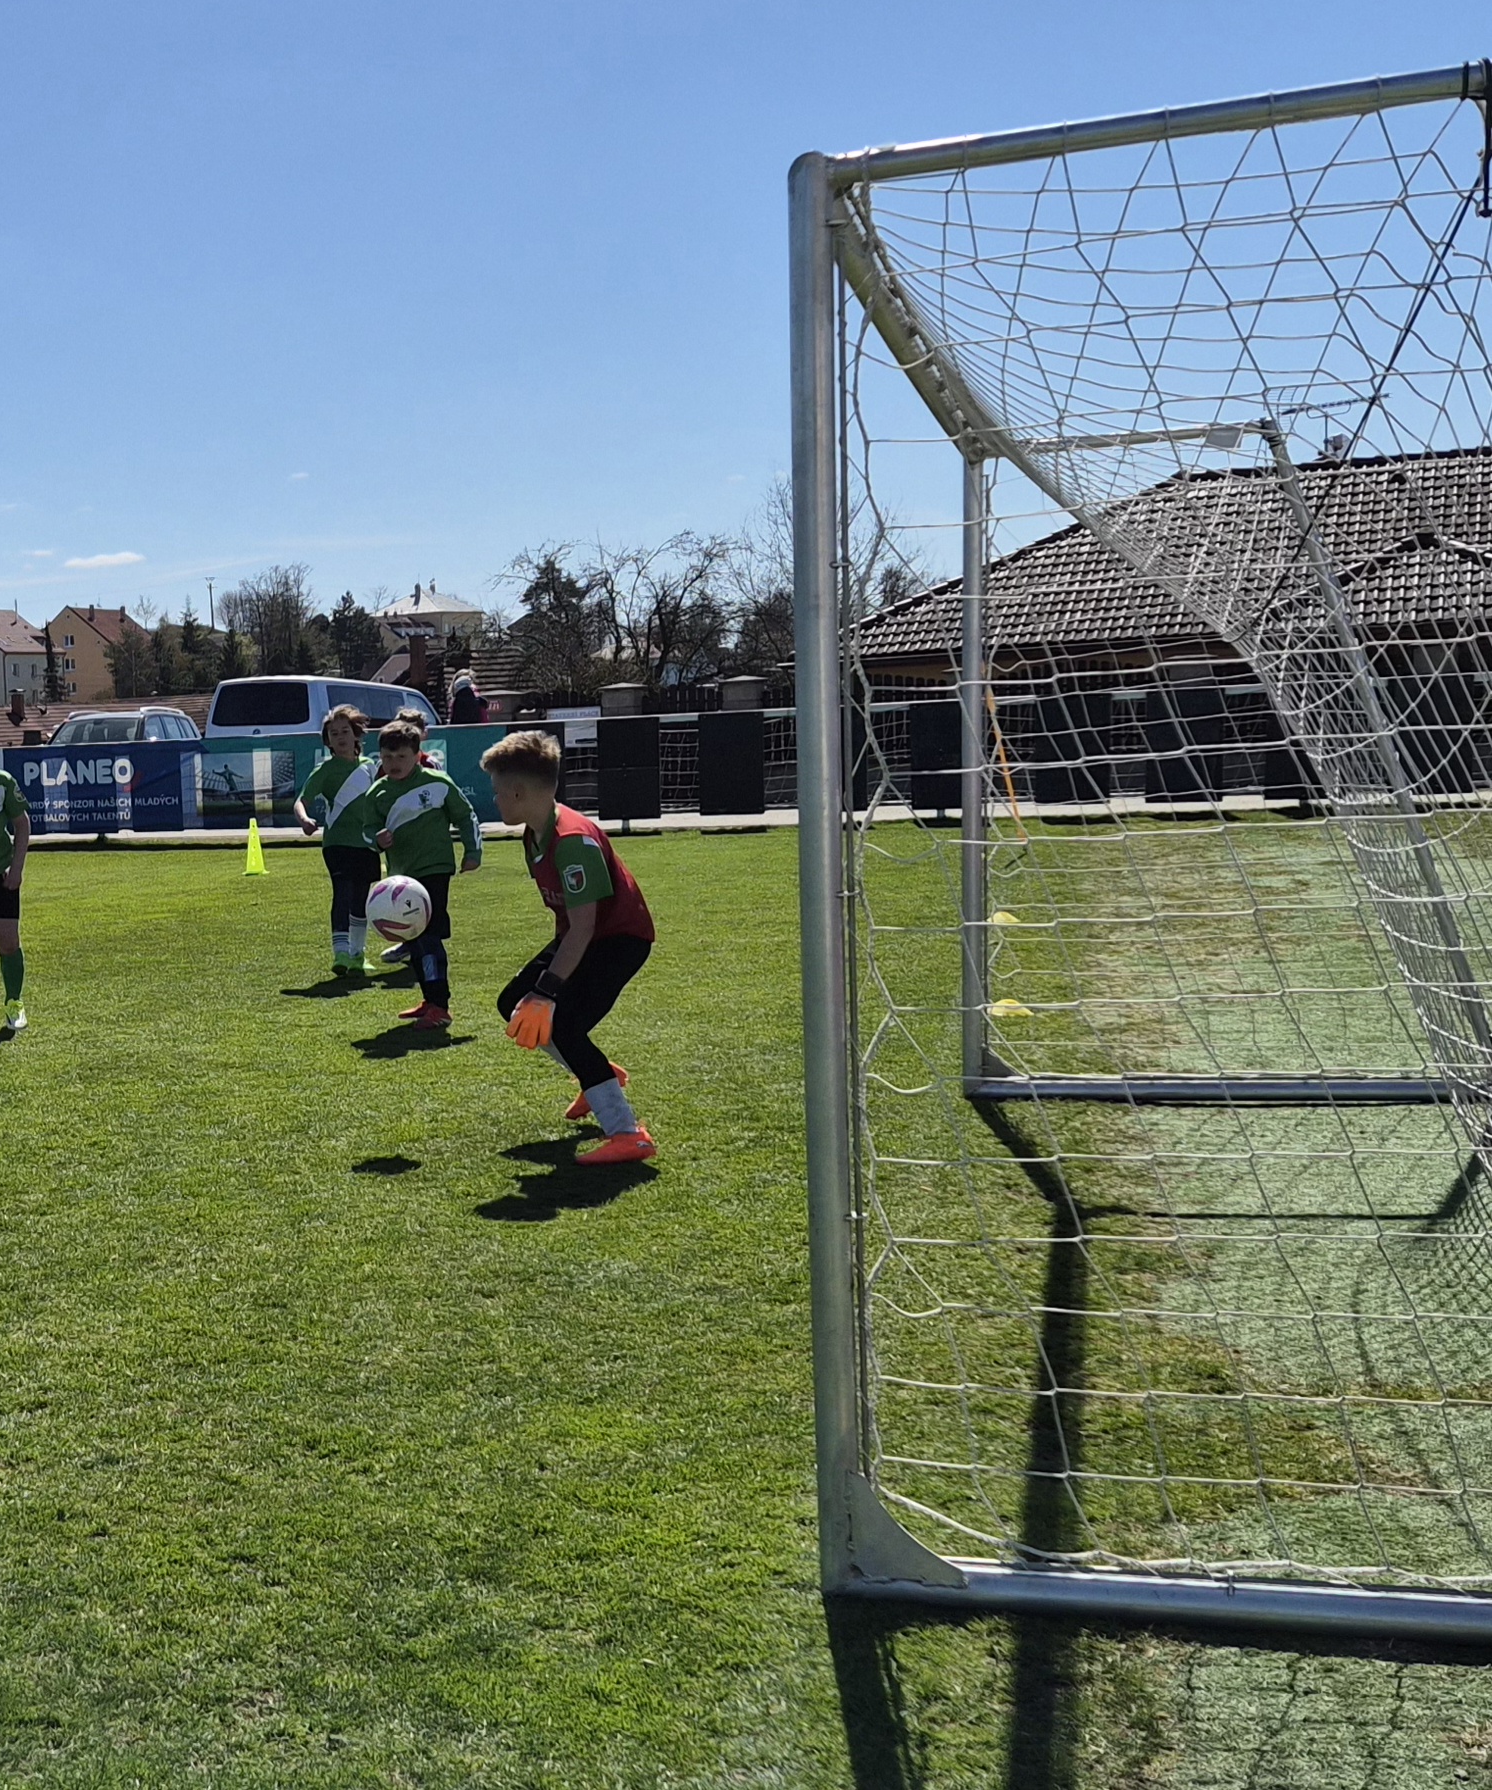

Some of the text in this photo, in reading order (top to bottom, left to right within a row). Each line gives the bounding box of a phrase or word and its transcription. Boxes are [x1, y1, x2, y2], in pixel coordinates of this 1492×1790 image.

[23, 758, 135, 787] PLANEO
[52, 799, 95, 809] SPONZOR
[97, 797, 132, 808] NAŠICH
[135, 794, 179, 806] MLADÝCH
[29, 808, 131, 823] OTBALOVÝCH TALENTŮ
